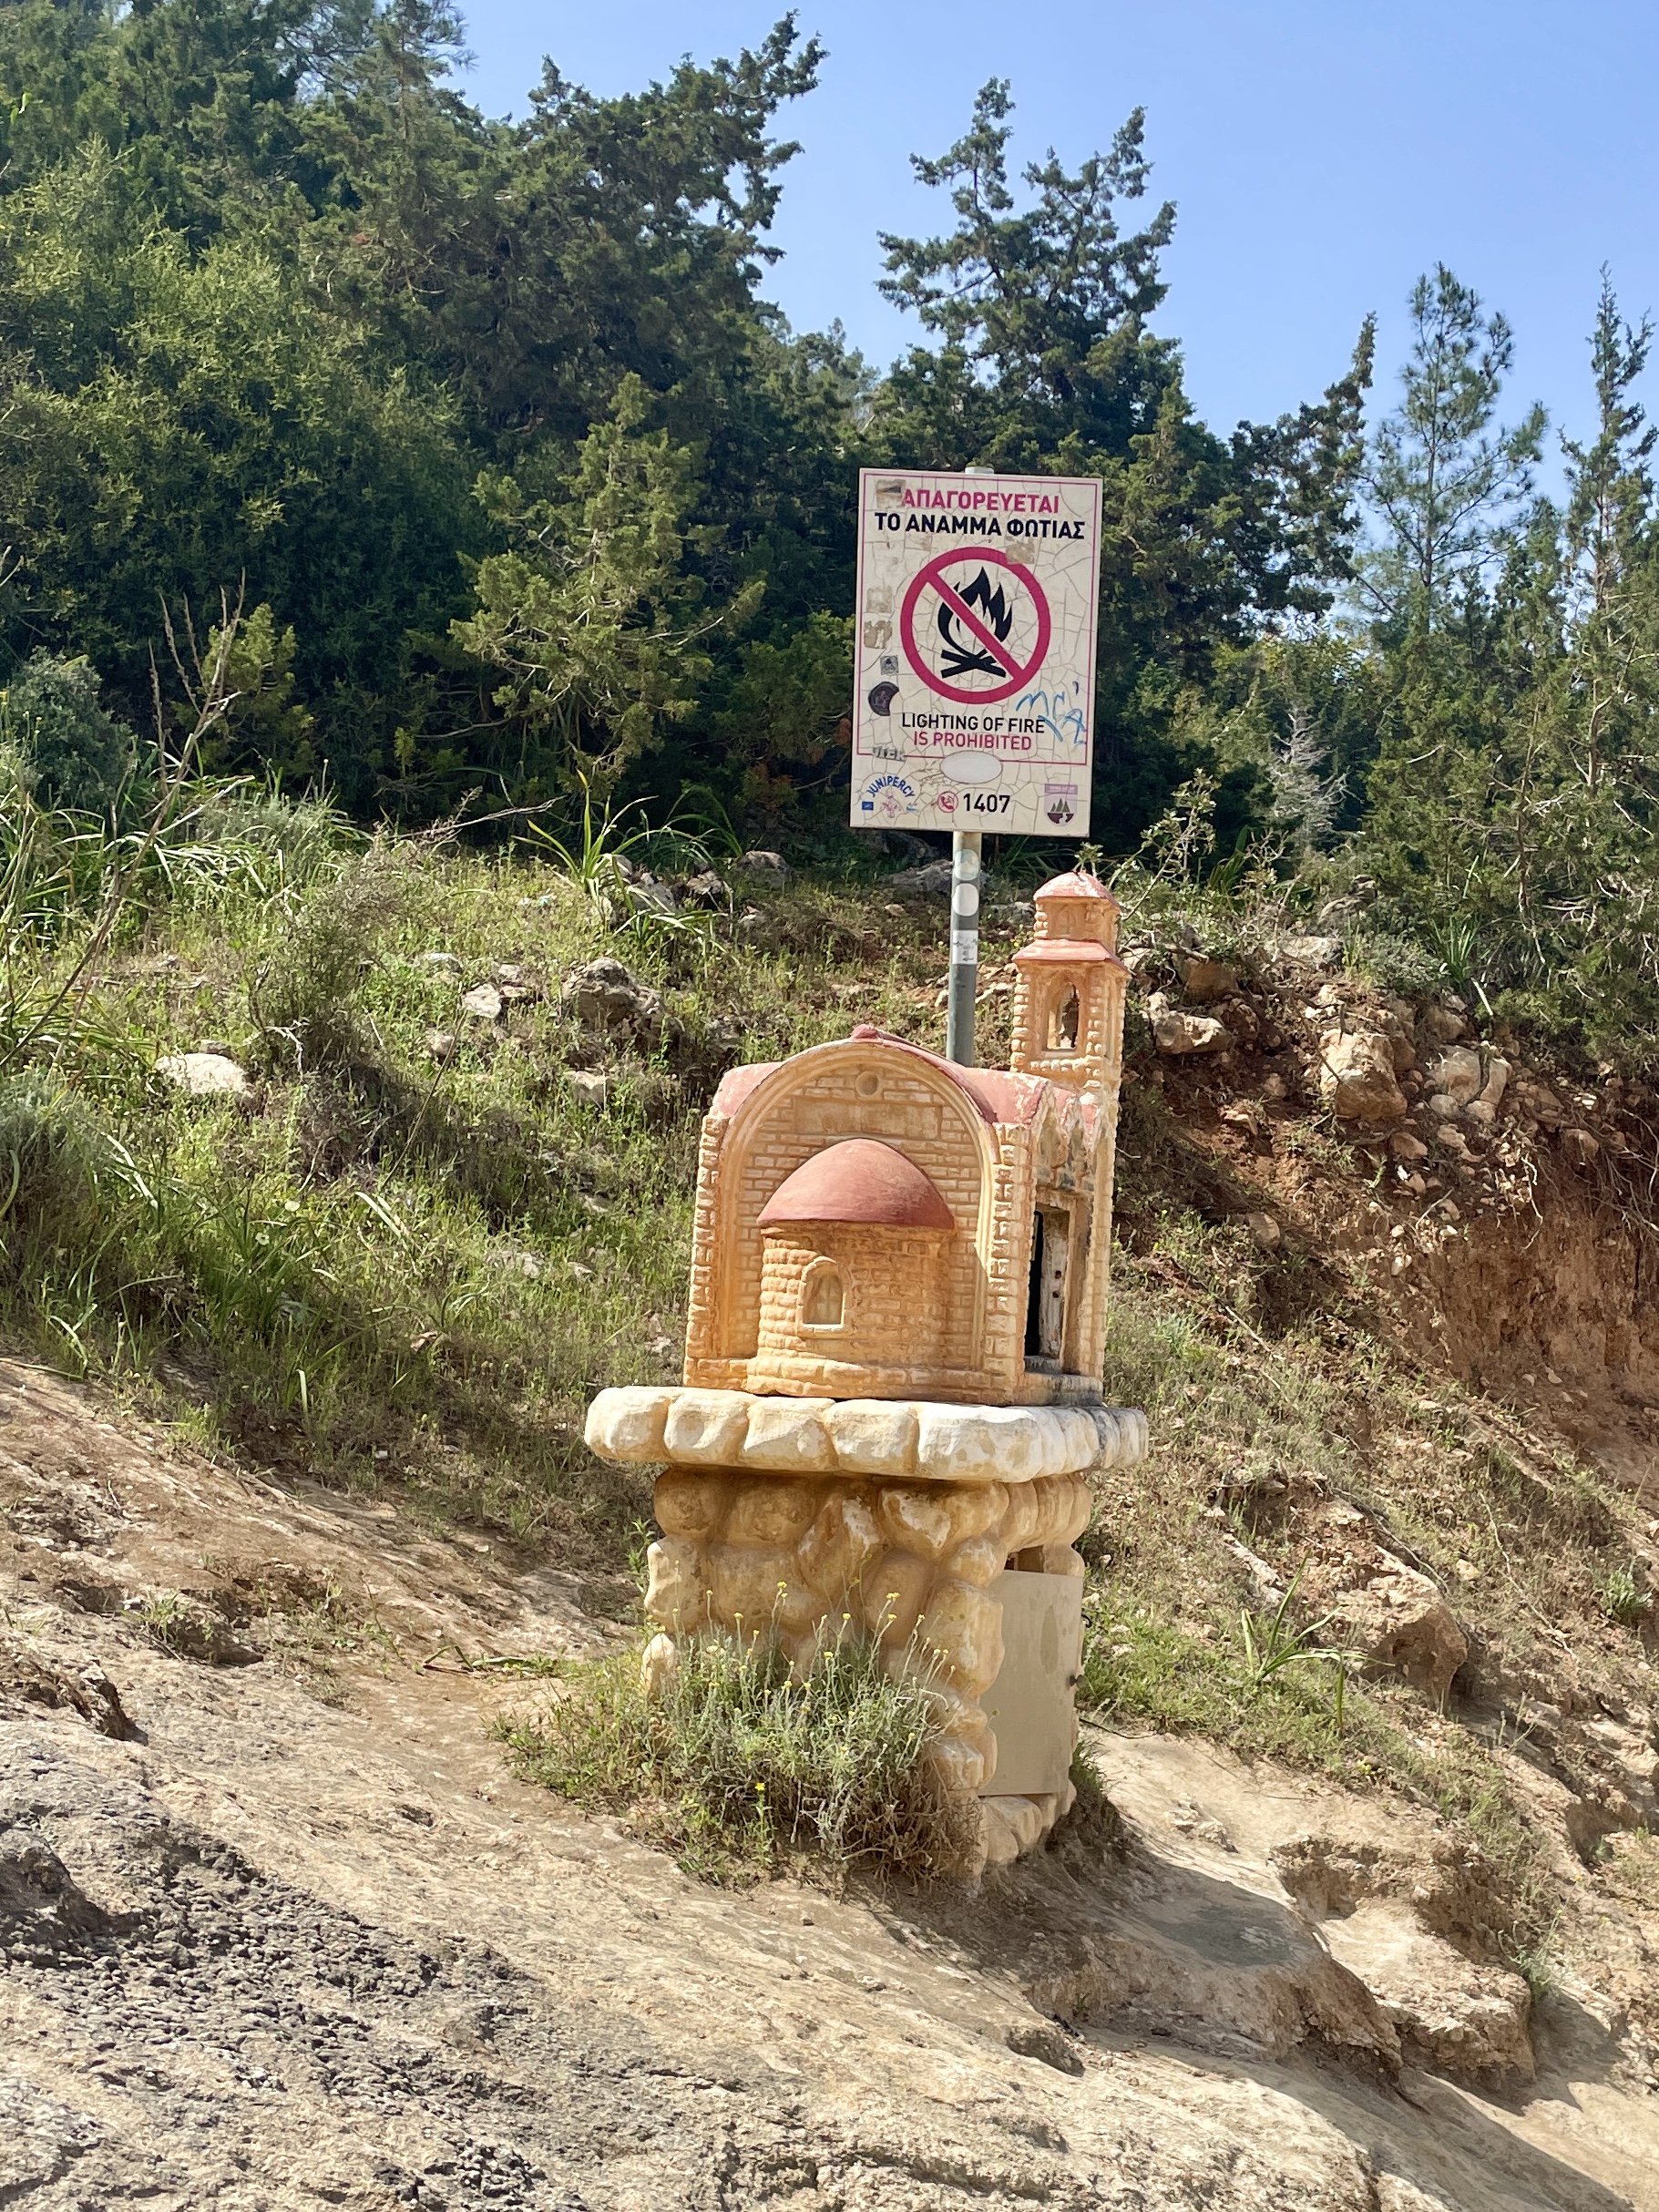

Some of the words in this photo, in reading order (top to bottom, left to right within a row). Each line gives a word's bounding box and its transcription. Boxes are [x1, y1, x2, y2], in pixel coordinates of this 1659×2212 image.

[901, 488, 1060, 513] ΑΠΑΓΟΡΕΥΕΤΑΙ
[875, 512, 901, 531] ΤΟ
[906, 514, 1002, 536] ΑΝΑΜΜΑ
[1007, 518, 1086, 539] ΦΩΤΙΑΣ
[902, 712, 978, 731] LIGHTING
[983, 717, 1004, 732] OF
[1009, 718, 1046, 733] FIRE
[914, 732, 928, 746] IS
[933, 732, 1032, 751] PROHIBITED
[866, 775, 916, 798] JUNIPERCY
[963, 793, 1010, 814] 1407
